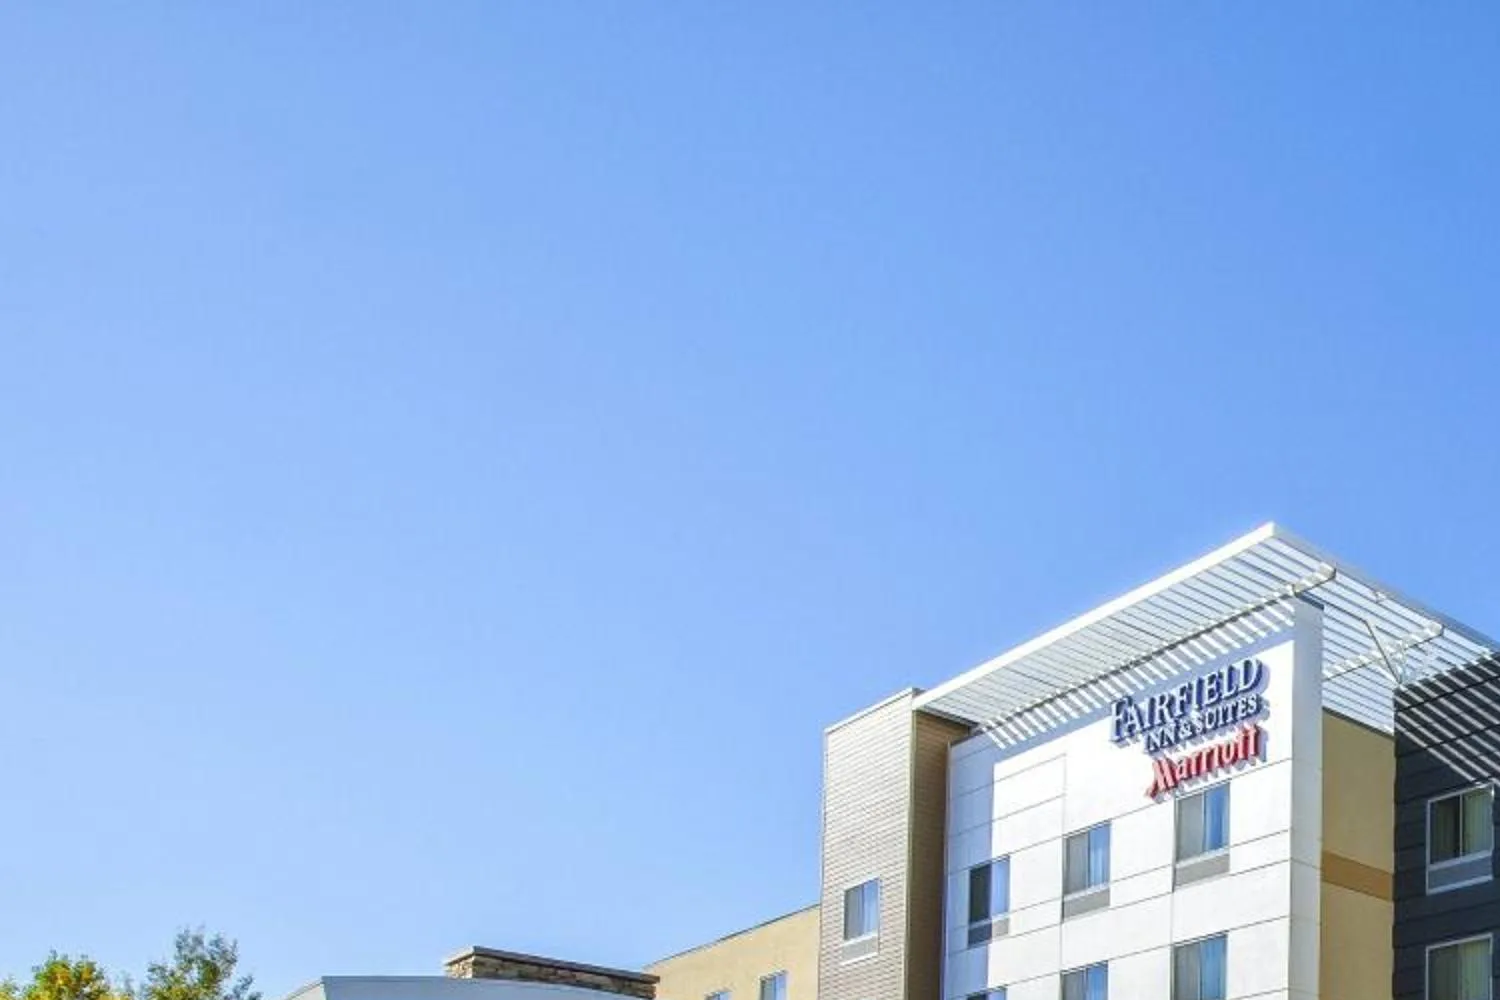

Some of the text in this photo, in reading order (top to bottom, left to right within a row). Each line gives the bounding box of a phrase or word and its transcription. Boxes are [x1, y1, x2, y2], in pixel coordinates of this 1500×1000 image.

[1110, 658, 1263, 743] FAIRFIELD
[1145, 693, 1263, 754] INN & SUITES
[1146, 723, 1261, 800] Marriott
